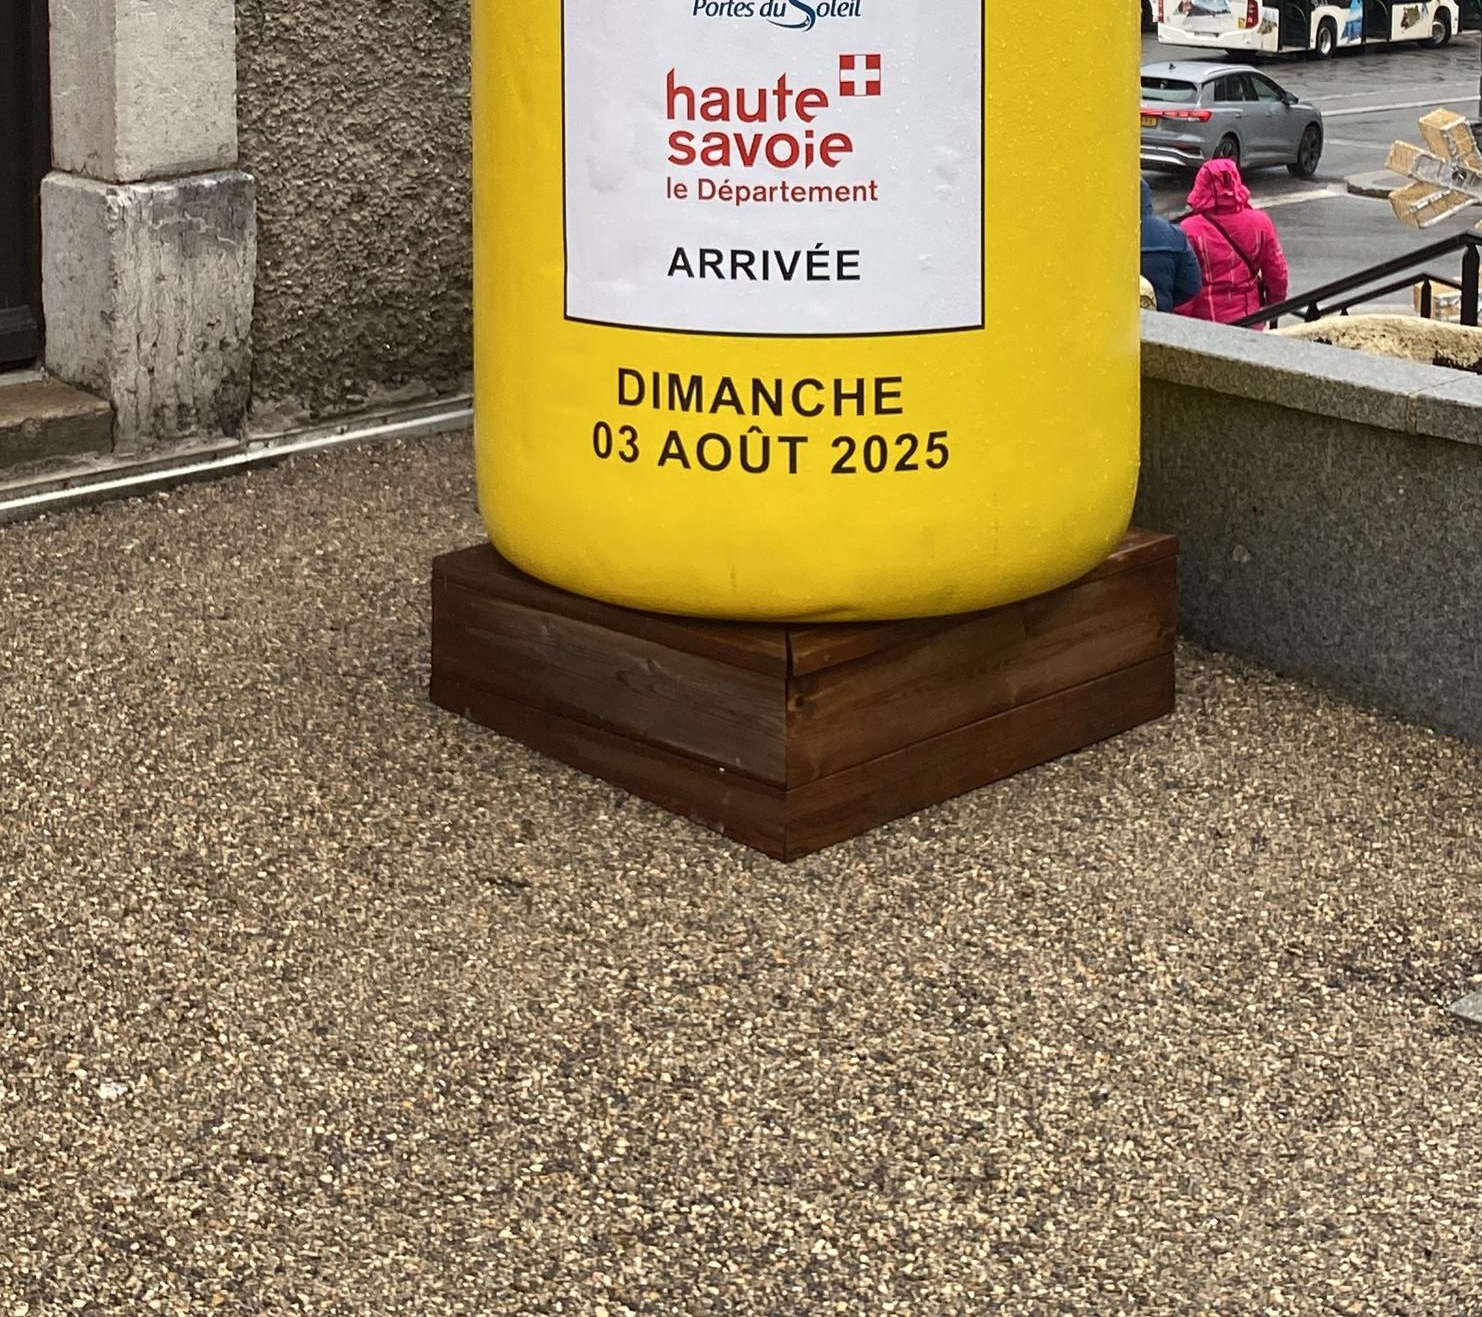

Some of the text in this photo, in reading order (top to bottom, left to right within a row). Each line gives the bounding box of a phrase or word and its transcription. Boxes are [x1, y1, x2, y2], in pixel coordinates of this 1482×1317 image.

[665, 67, 830, 124] haute
[667, 129, 854, 170] savoie
[666, 177, 879, 207] le Département
[666, 242, 861, 282] ARRIVÉE
[617, 366, 904, 418] DIMANCHE
[592, 420, 950, 475] 03 AOÛT 2025
